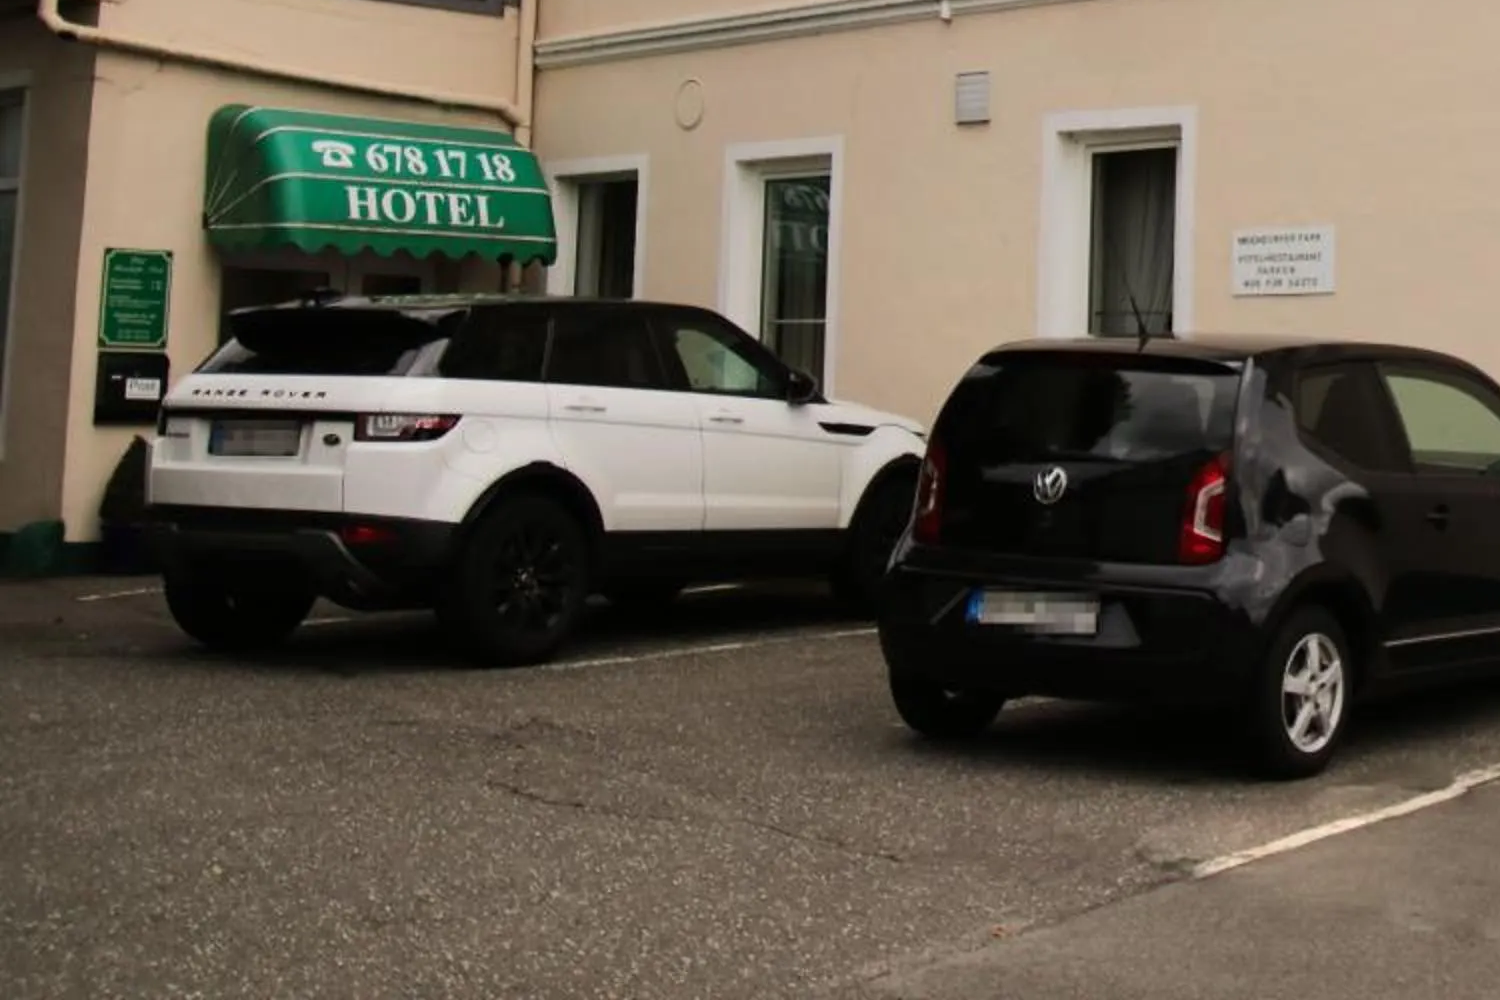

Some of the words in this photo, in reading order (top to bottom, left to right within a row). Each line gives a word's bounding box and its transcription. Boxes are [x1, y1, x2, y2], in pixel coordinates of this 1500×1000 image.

[365, 143, 429, 176] 678
[432, 149, 467, 180] 17
[475, 151, 516, 183] 18
[345, 184, 505, 229] HOTEL
[261, 388, 327, 399] ROVER
